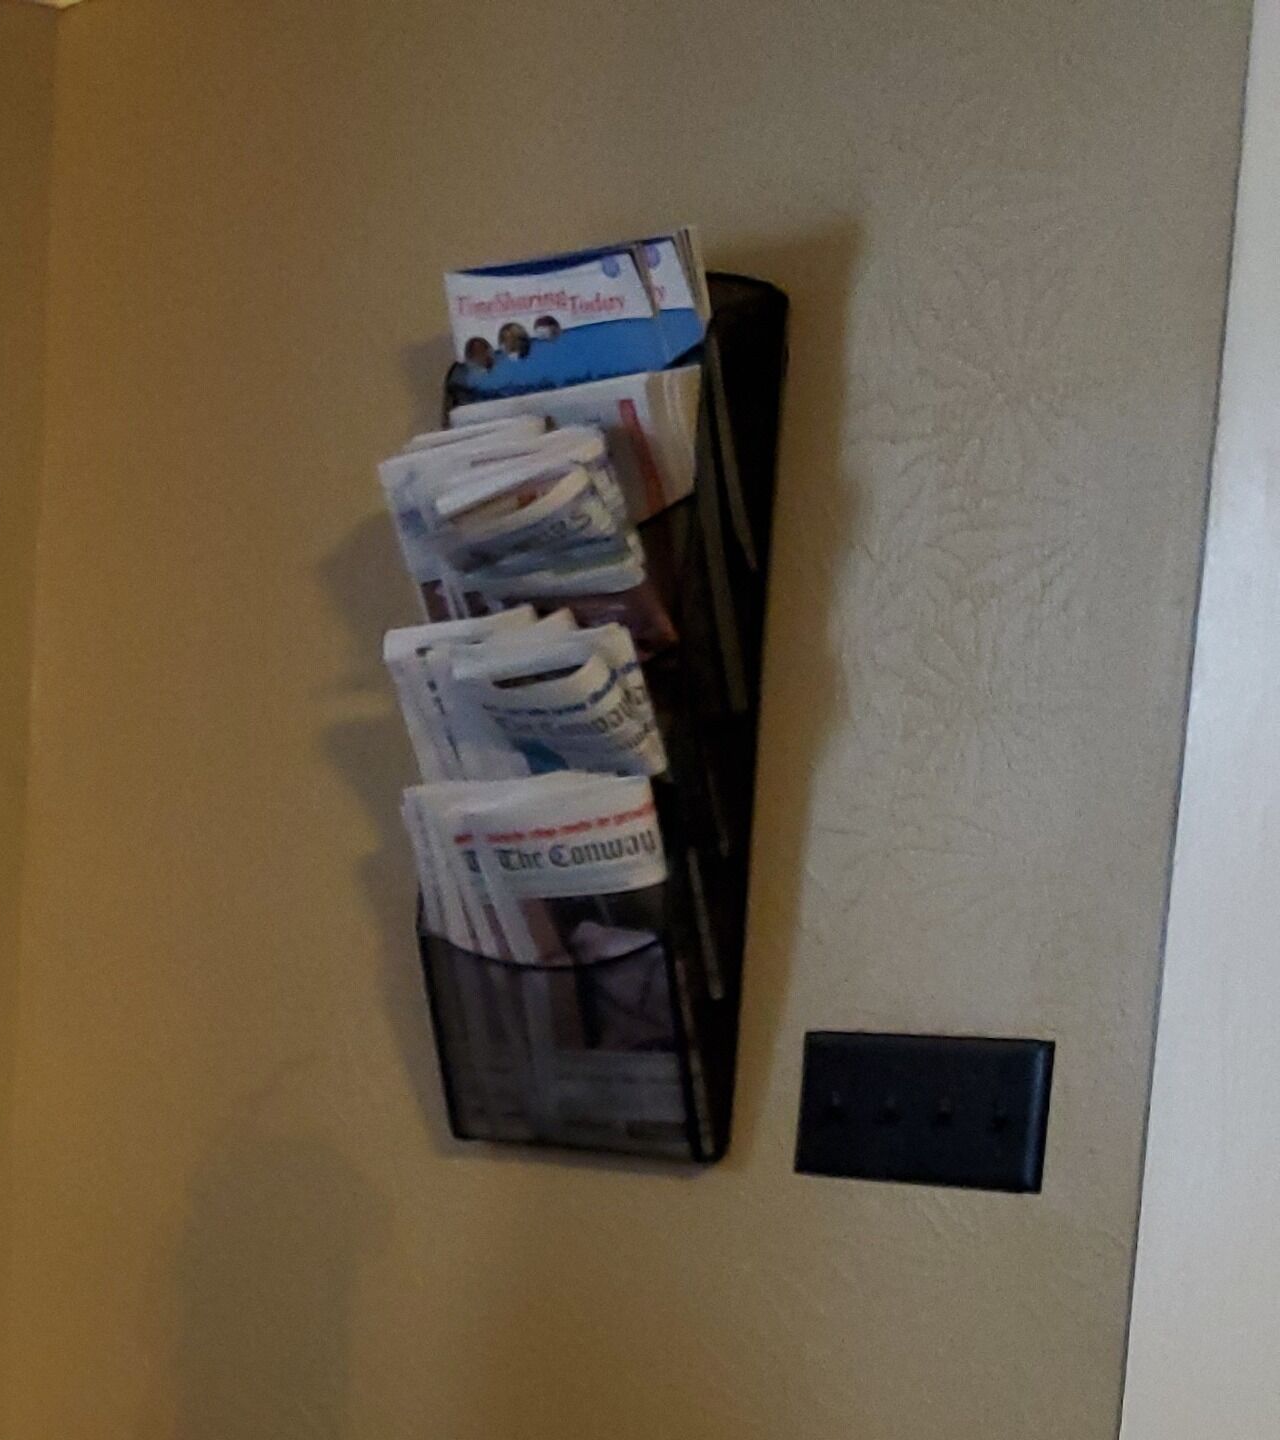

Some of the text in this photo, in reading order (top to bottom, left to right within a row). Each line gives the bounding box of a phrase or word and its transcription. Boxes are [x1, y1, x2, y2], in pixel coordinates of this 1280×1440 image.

[569, 292, 626, 314] Today
[493, 848, 545, 872] The
[548, 830, 658, 868] Conway
